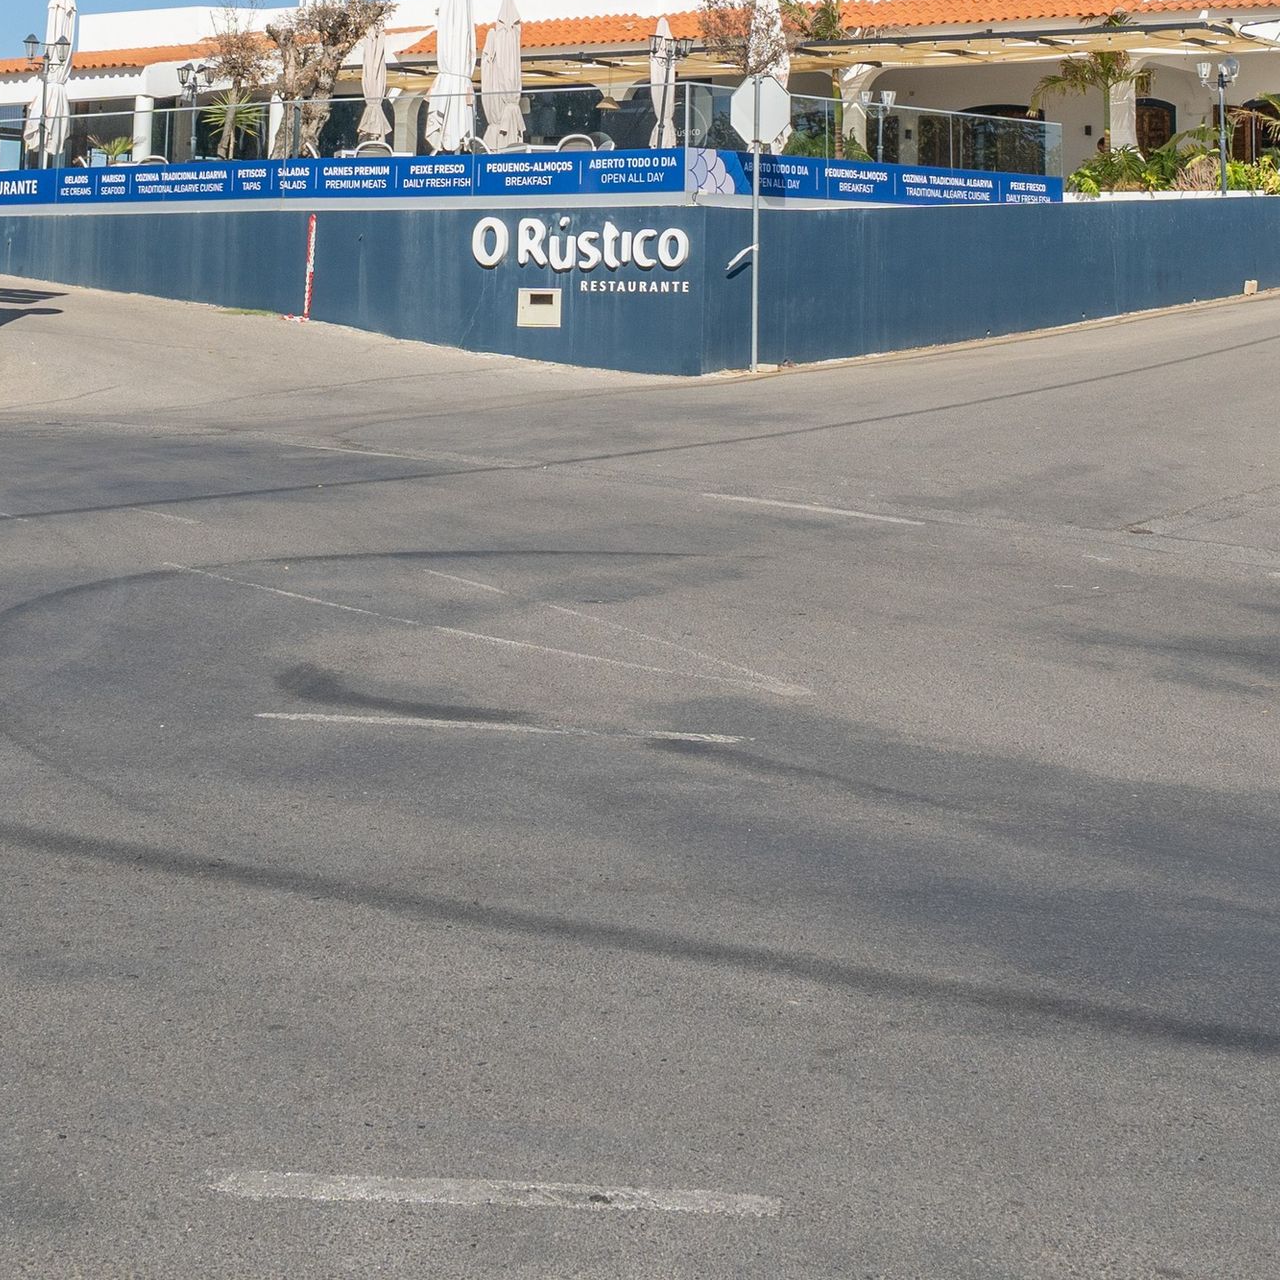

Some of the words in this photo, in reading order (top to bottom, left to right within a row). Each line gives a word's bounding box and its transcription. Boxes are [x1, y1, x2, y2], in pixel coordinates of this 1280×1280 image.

[487, 161, 573, 173] PEQUENOS-ALMOÇOS
[589, 158, 624, 170] ABERTO
[627, 158, 650, 168] TODO
[652, 158, 658, 167] O
[661, 156, 677, 167] DIA
[238, 168, 266, 178] PETISCOS
[278, 167, 310, 177] SALADAS
[323, 166, 352, 176] CARNES
[354, 166, 390, 176] PREMIUM
[410, 164, 432, 174] PEIXE
[434, 164, 464, 174] FRESCO
[744, 162, 770, 172] ABRTO
[772, 164, 790, 174] TODO
[791, 165, 796, 175] O
[797, 166, 808, 176] DIA
[64, 176, 88, 184] GELADOS
[102, 174, 126, 183] MARISCO
[136, 172, 159, 182] COZINHA
[506, 176, 552, 186] BREAKFAST
[601, 174, 626, 184] OPEN
[628, 173, 644, 182] ALL
[647, 172, 664, 182] DAY
[200, 182, 223, 192] CUISINE
[242, 182, 261, 191] TAPAS
[280, 180, 306, 190] SALADS
[326, 180, 360, 189] PREMIUM
[362, 179, 386, 189] MEATS
[404, 178, 424, 188] DAILY
[426, 178, 451, 188] FRESH
[454, 178, 470, 187] FISH
[774, 179, 786, 188] ALL
[788, 179, 800, 190] DAY
[839, 182, 874, 194] BREAKFAST
[1010, 182, 1026, 191] PEIXE
[1026, 182, 1046, 192] FRESCO
[60, 188, 69, 196] ICE
[101, 186, 126, 196] SEAFOOD
[1006, 194, 1020, 202] DAILY
[1022, 194, 1038, 202] FRESH
[472, 217, 508, 268] O
[580, 281, 689, 293] RESTAURANTE
